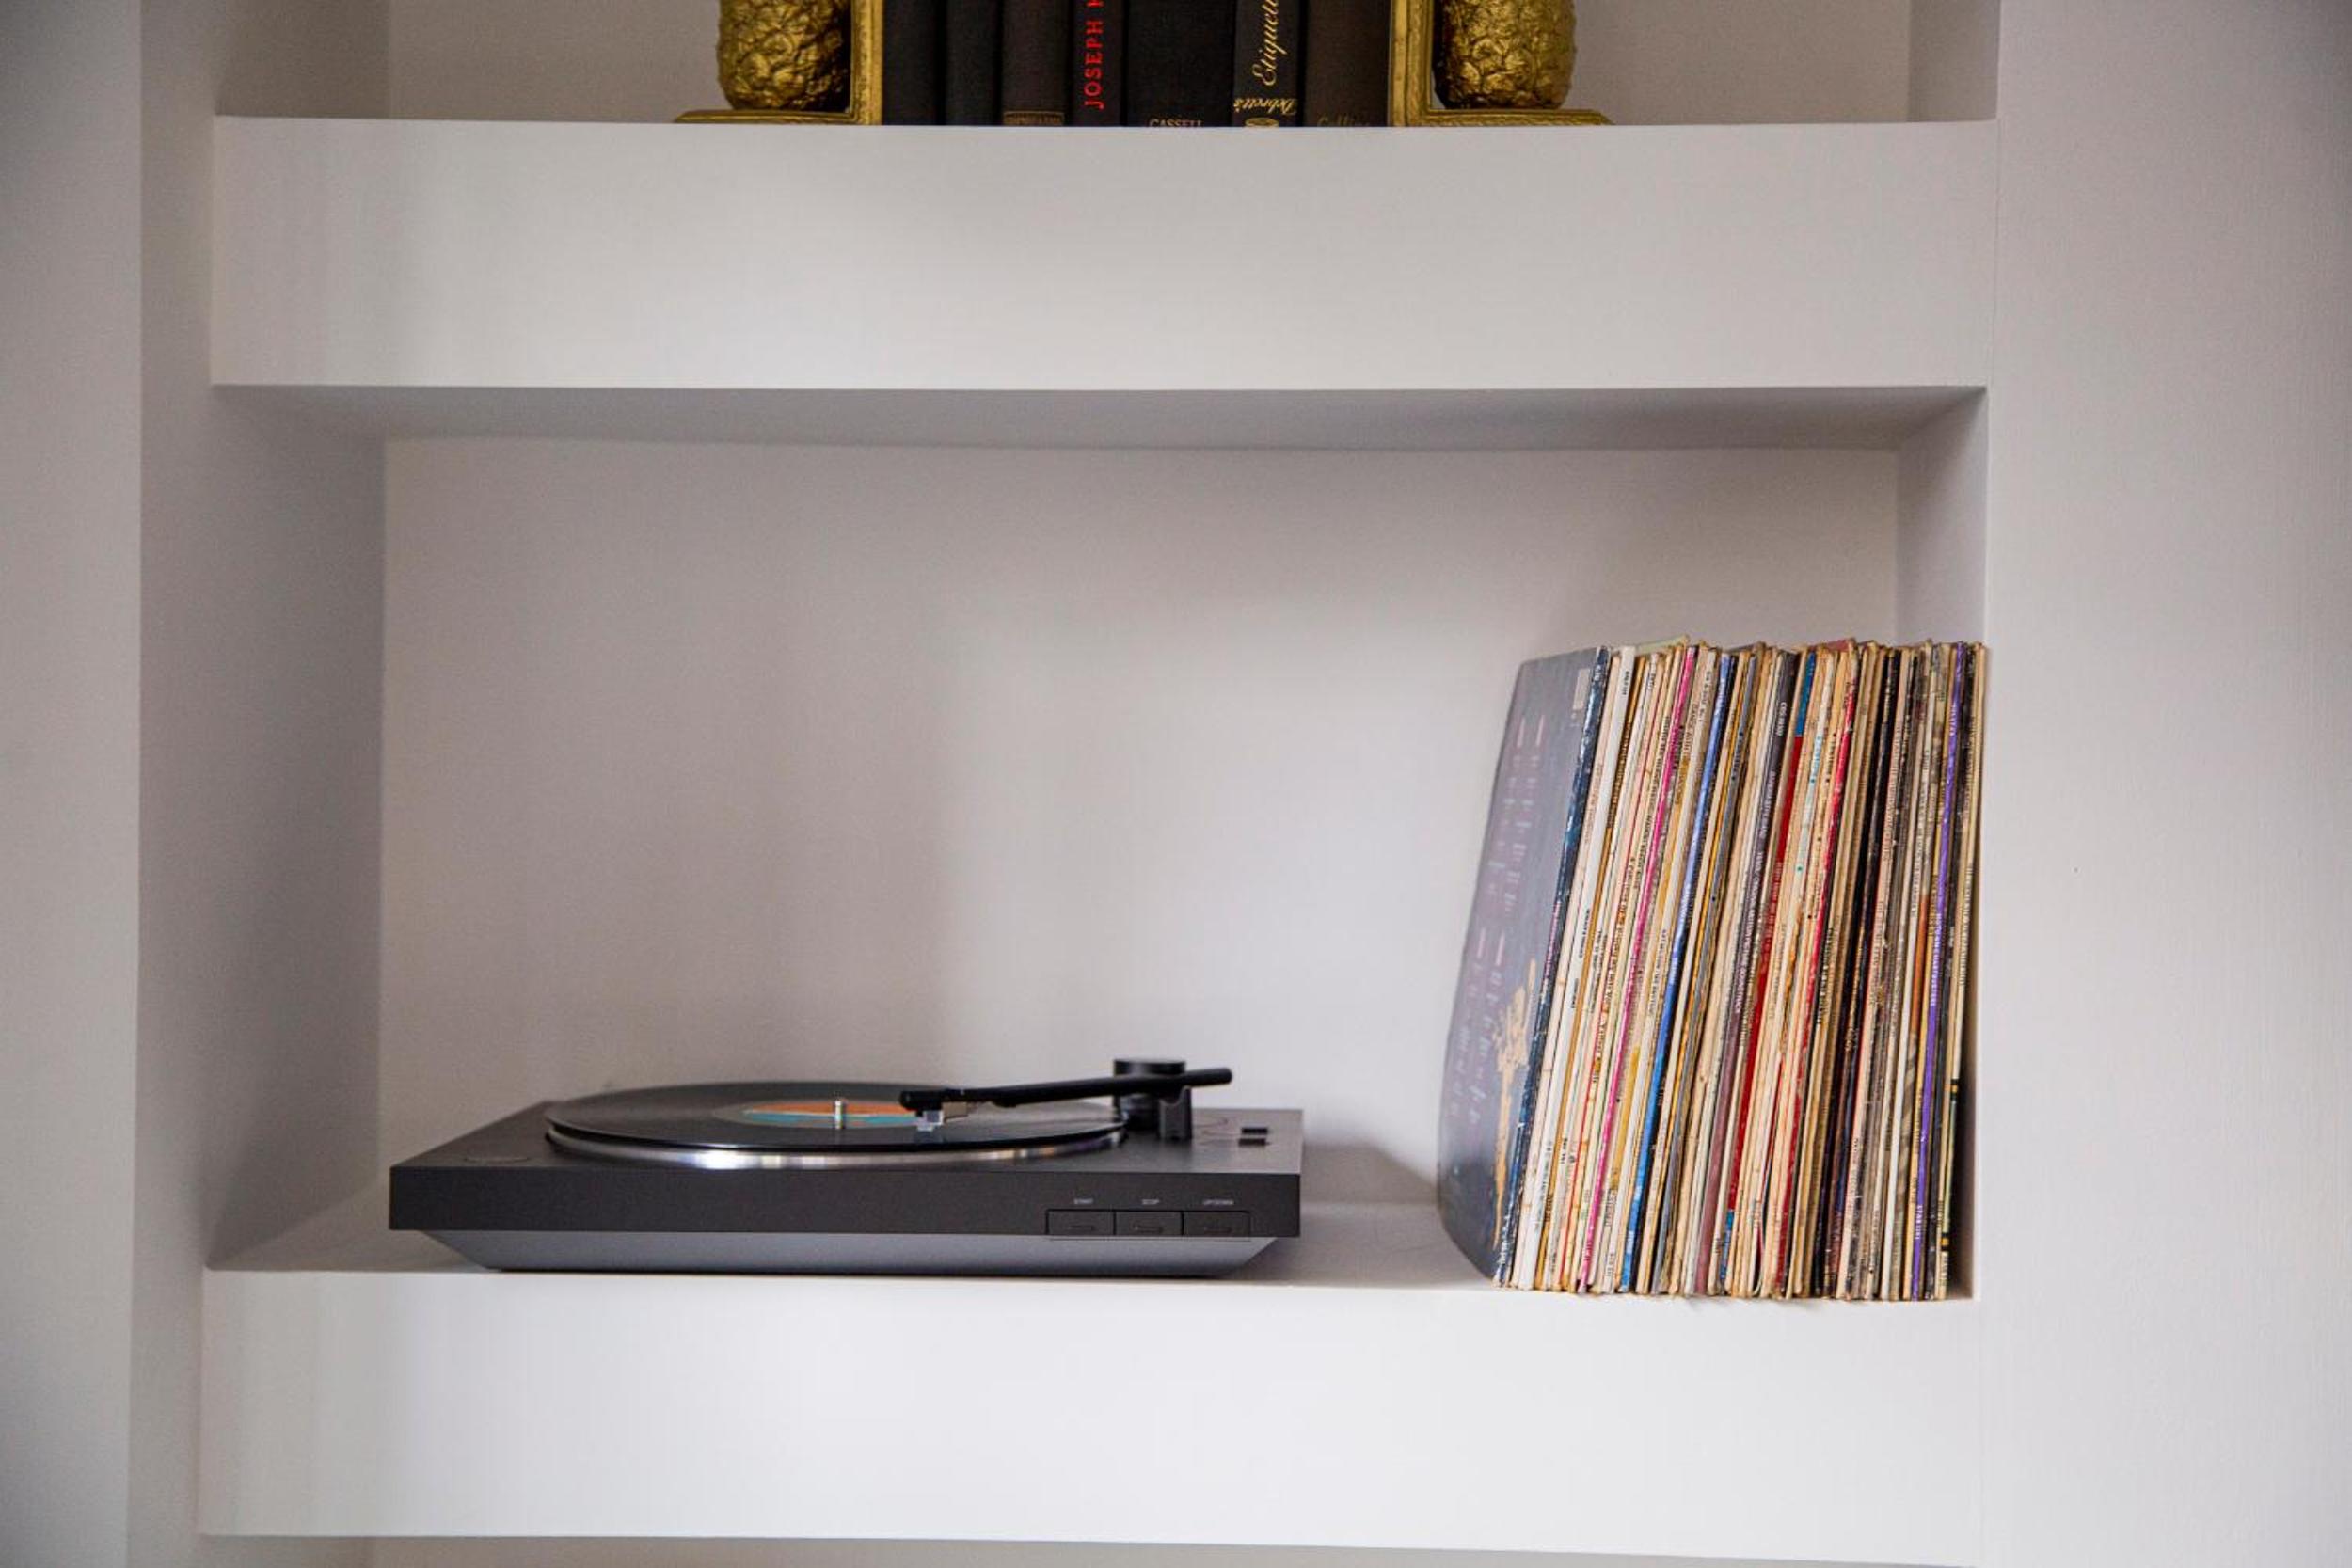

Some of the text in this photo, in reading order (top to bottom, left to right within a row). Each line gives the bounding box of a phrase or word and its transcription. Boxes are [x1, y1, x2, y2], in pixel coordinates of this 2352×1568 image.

[1083, 20, 1105, 110] JOSEPH
[1232, 98, 1297, 115] Debrett's
[1686, 703, 1698, 729] DANCE
[1778, 701, 1787, 716] CBS
[1682, 731, 1693, 752] WITH
[1673, 766, 1687, 805] SHADOWS
[1757, 800, 1771, 838] STREISAND
[1748, 876, 1759, 907] ORIGINAL
[1744, 909, 1755, 936] MOTION
[1933, 912, 1942, 946] MOTOWN
[1740, 937, 1751, 966] PICTURE
[1734, 967, 1747, 1014] SOUNDTRACK
[1930, 946, 1939, 1006] CHARTBUSTERS
